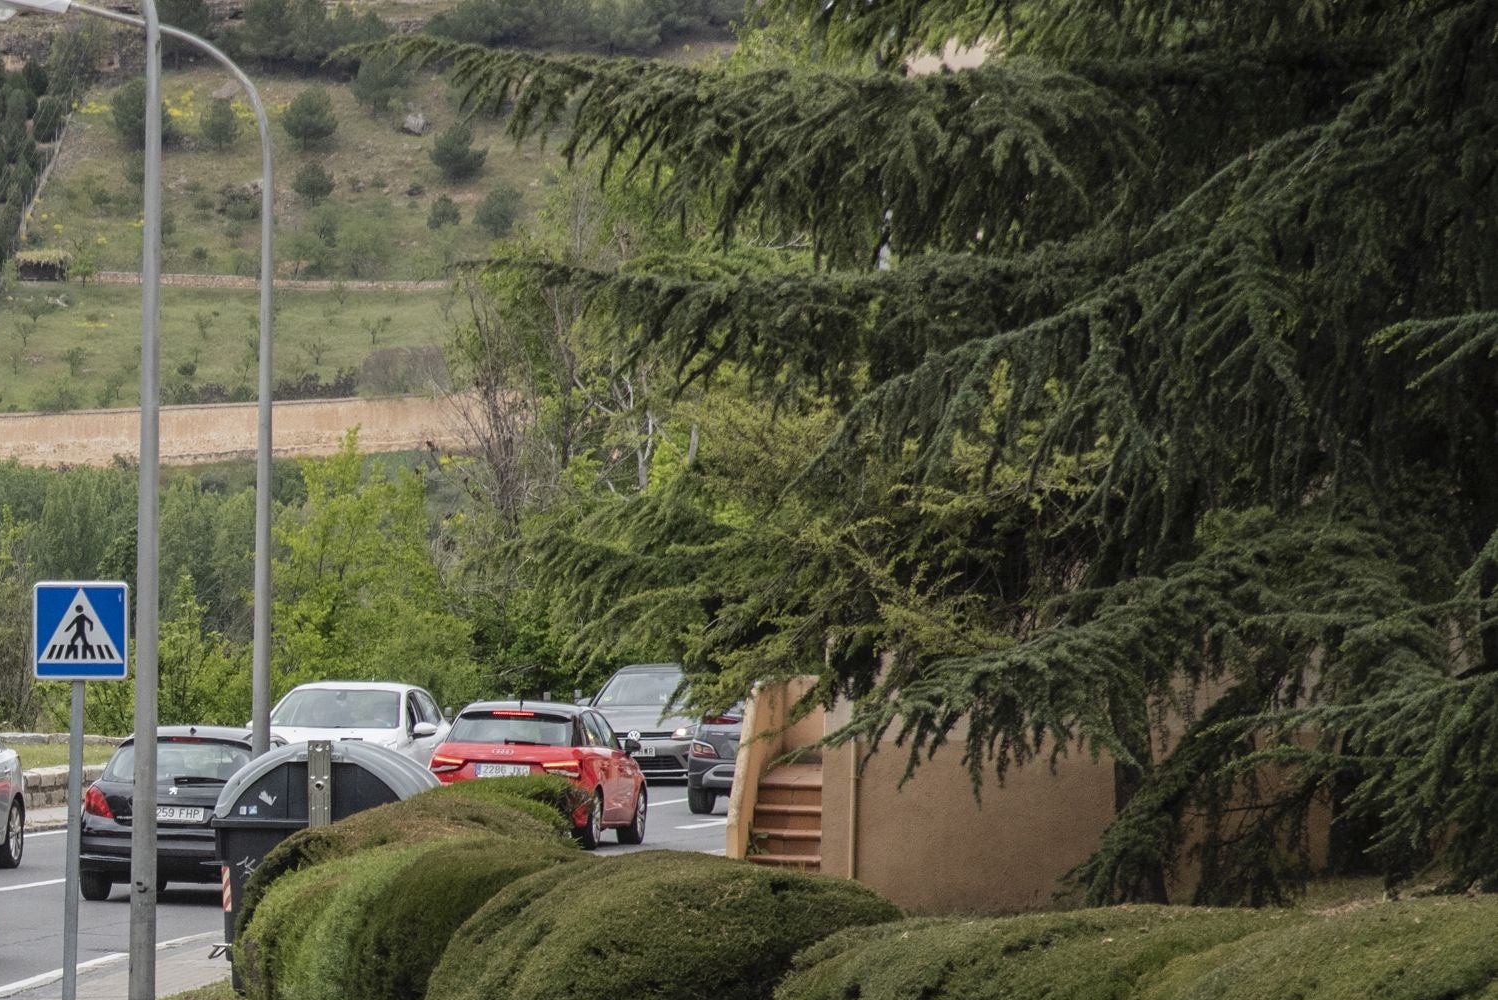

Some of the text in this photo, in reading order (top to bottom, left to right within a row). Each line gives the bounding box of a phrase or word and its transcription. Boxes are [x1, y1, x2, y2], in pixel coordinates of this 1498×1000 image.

[482, 765, 507, 774] 2286
[157, 807, 200, 818] 259 FHP
